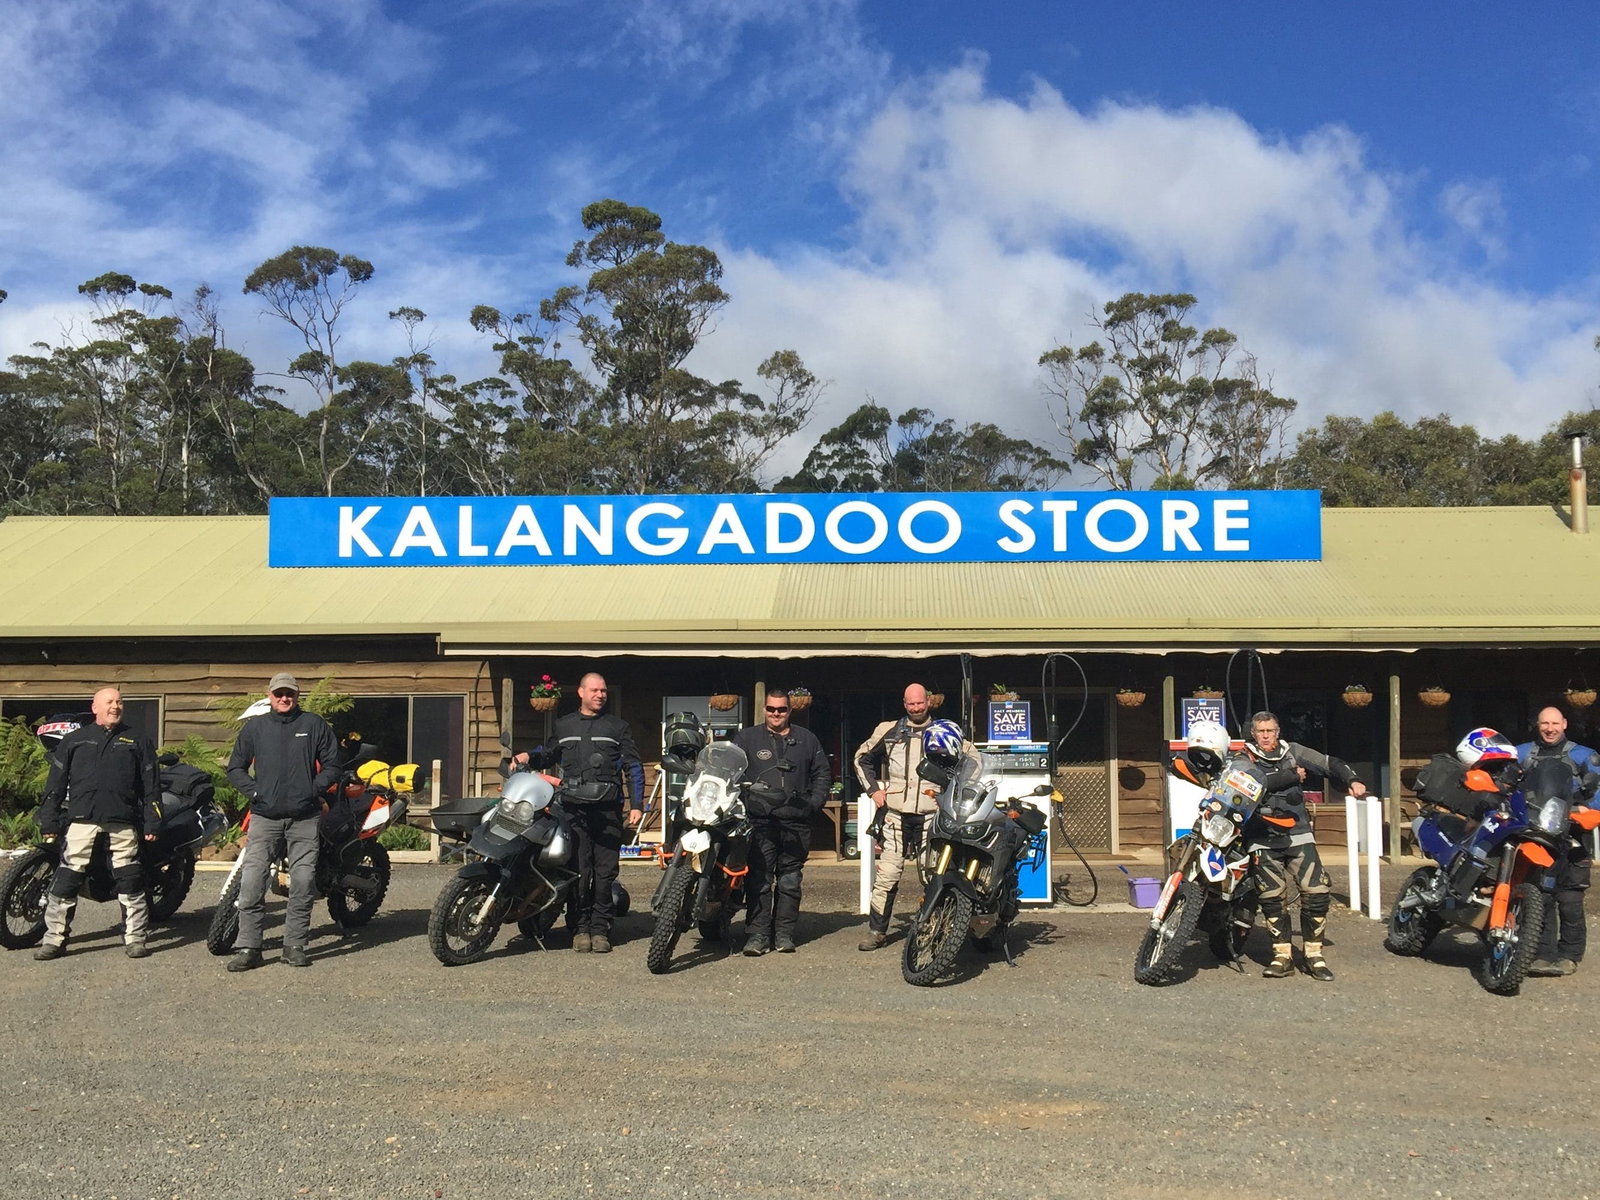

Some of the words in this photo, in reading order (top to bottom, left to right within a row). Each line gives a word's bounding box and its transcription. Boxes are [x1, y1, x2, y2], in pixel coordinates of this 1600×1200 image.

[338, 499, 962, 558] KALANGADOO
[997, 498, 1250, 554] STORE
[994, 713, 1026, 724] SAVE
[1187, 710, 1220, 721] SAVE
[1040, 758, 1048, 767] 2
